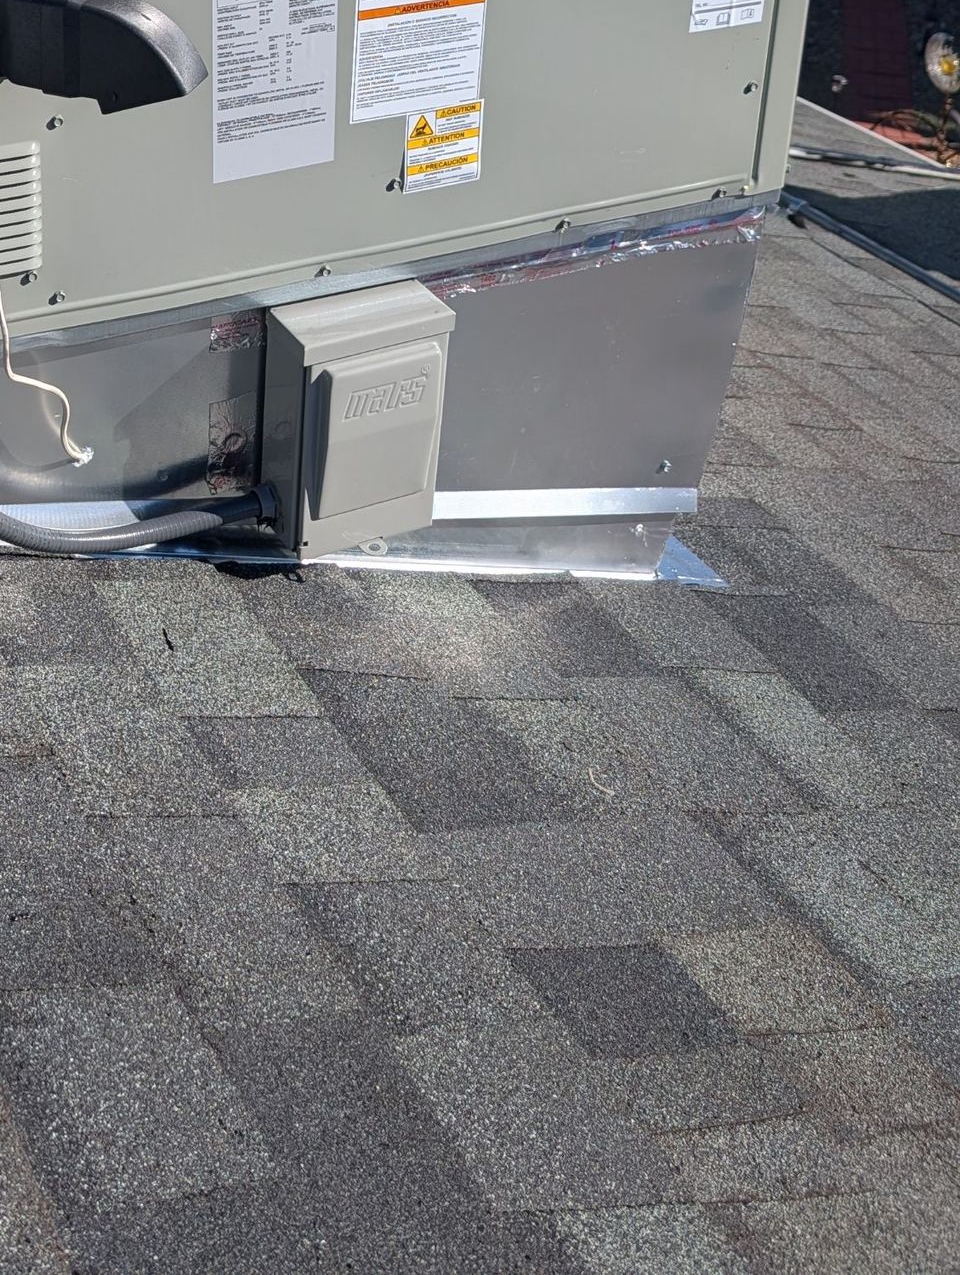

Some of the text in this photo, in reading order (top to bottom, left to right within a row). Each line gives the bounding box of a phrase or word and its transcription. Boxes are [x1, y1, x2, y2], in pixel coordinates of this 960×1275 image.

[402, 1, 450, 13] ADVERTENCIA
[447, 105, 476, 115] CAUTION
[429, 132, 464, 144] ATTENTION
[425, 156, 468, 171] PRECAUCIÓN
